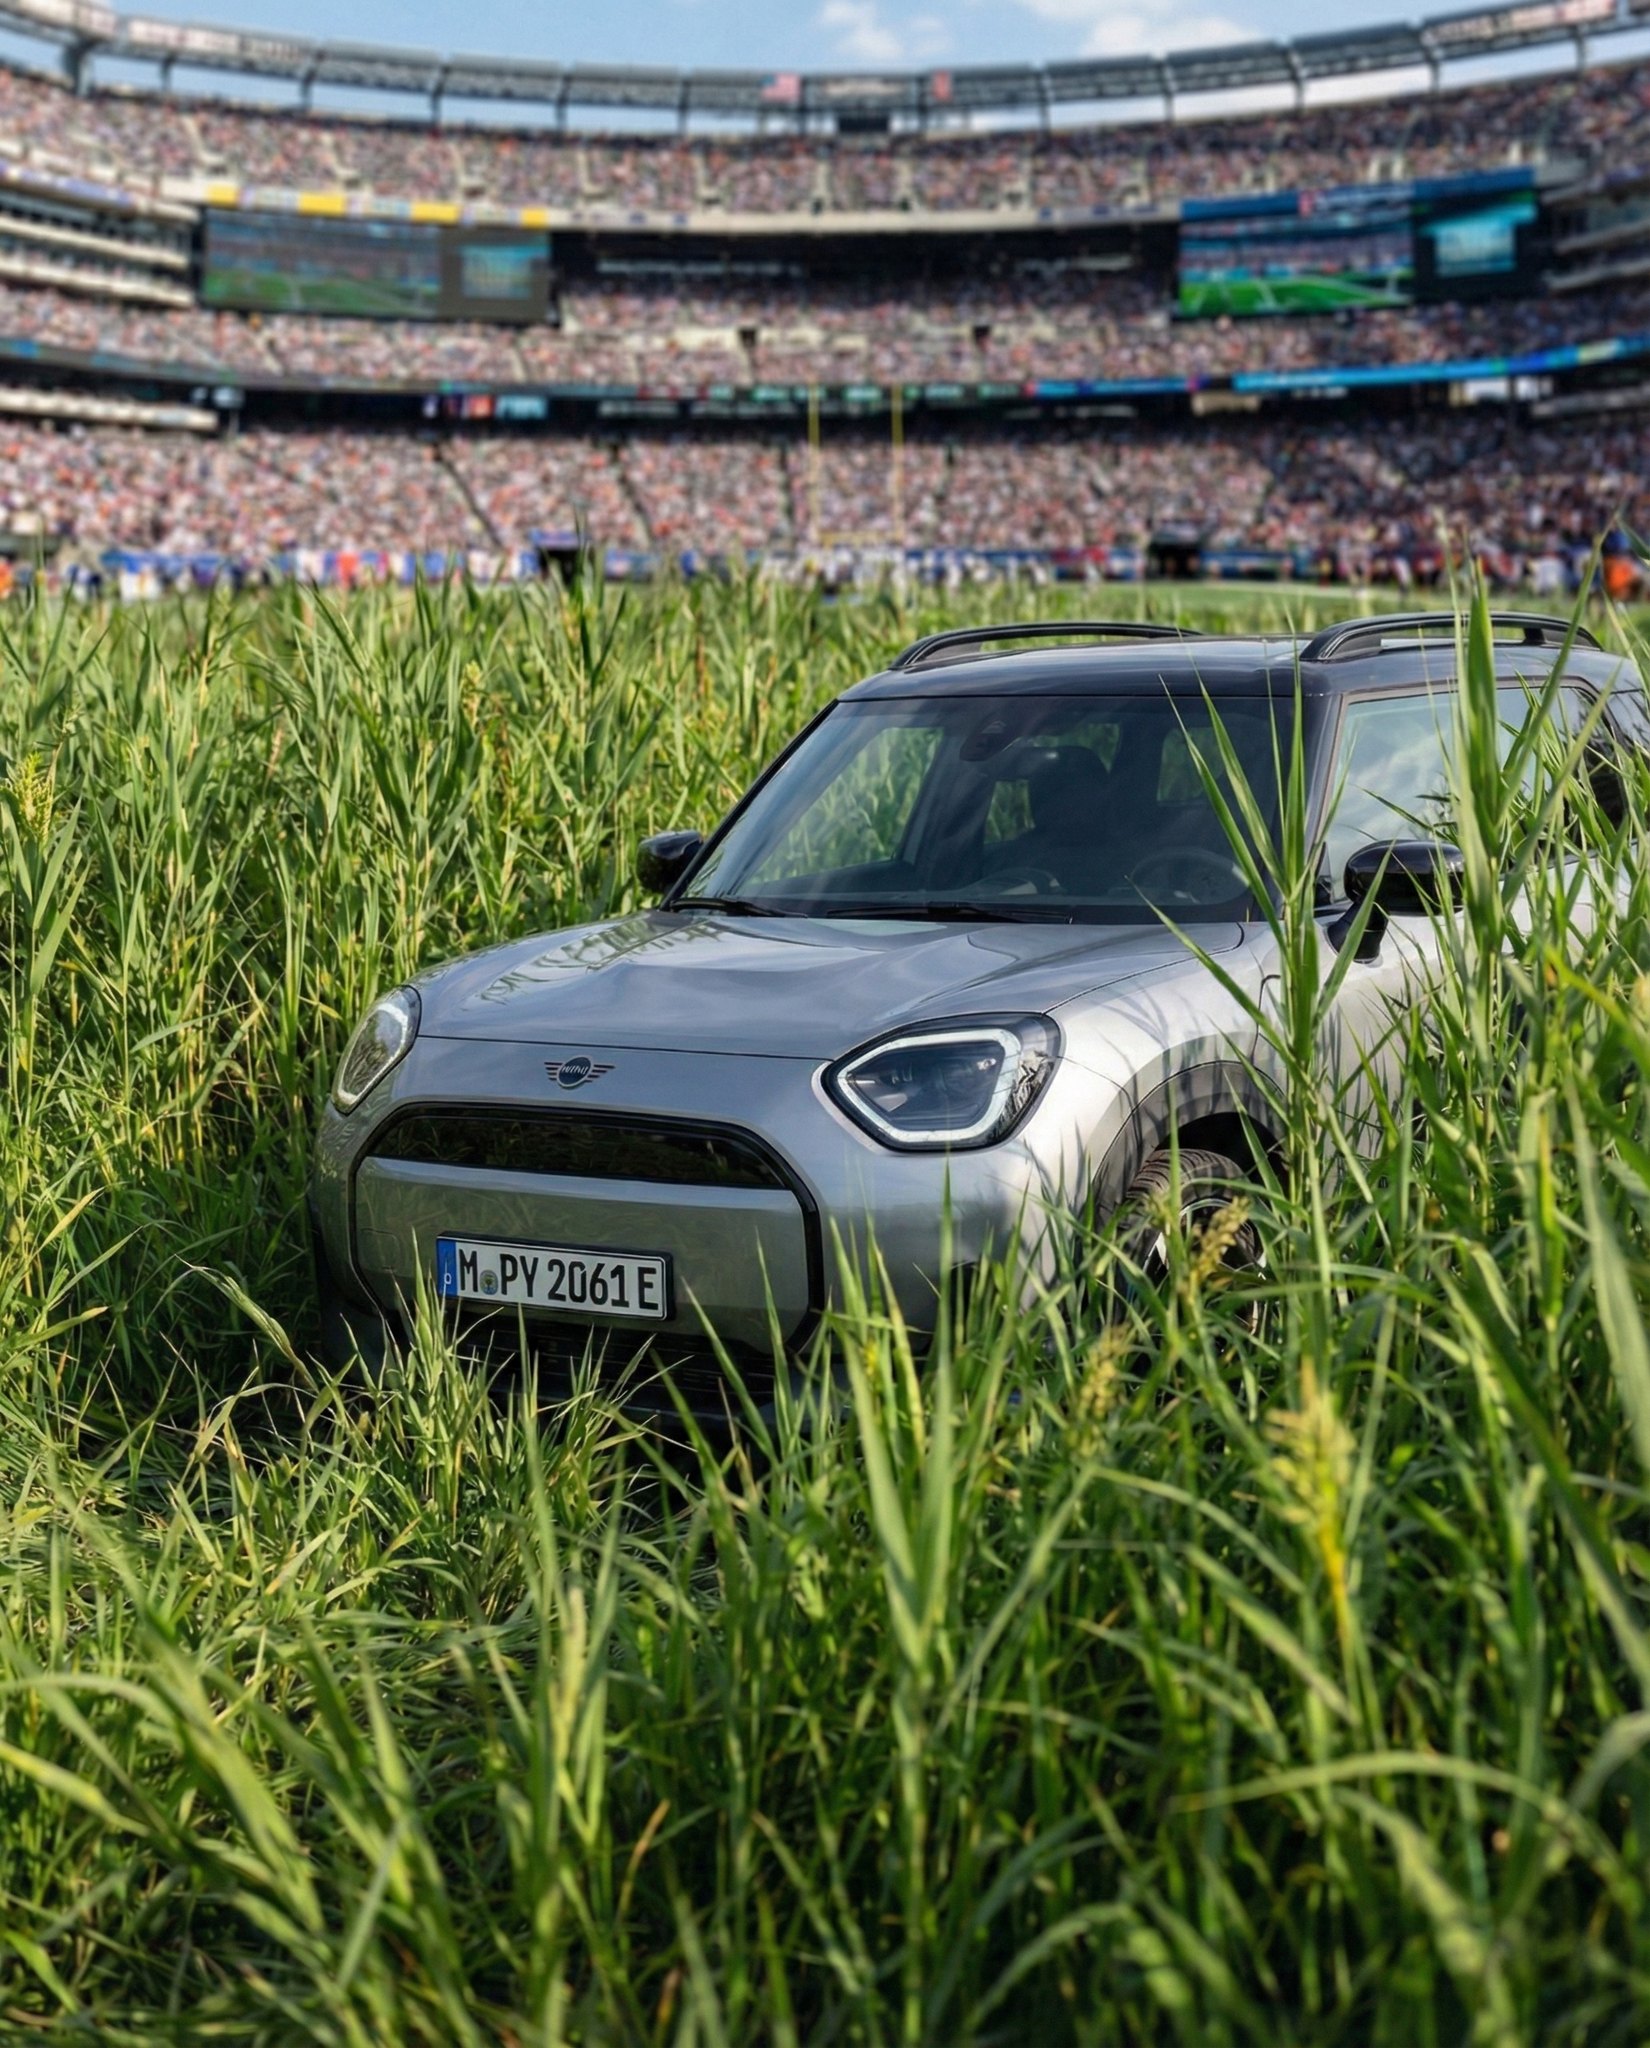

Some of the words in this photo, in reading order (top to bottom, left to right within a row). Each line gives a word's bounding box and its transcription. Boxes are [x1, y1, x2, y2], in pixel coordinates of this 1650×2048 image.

[459, 1249, 479, 1293] M
[500, 1253, 539, 1298] PY
[547, 1258, 630, 1308] 2061
[637, 1266, 659, 1311] E
